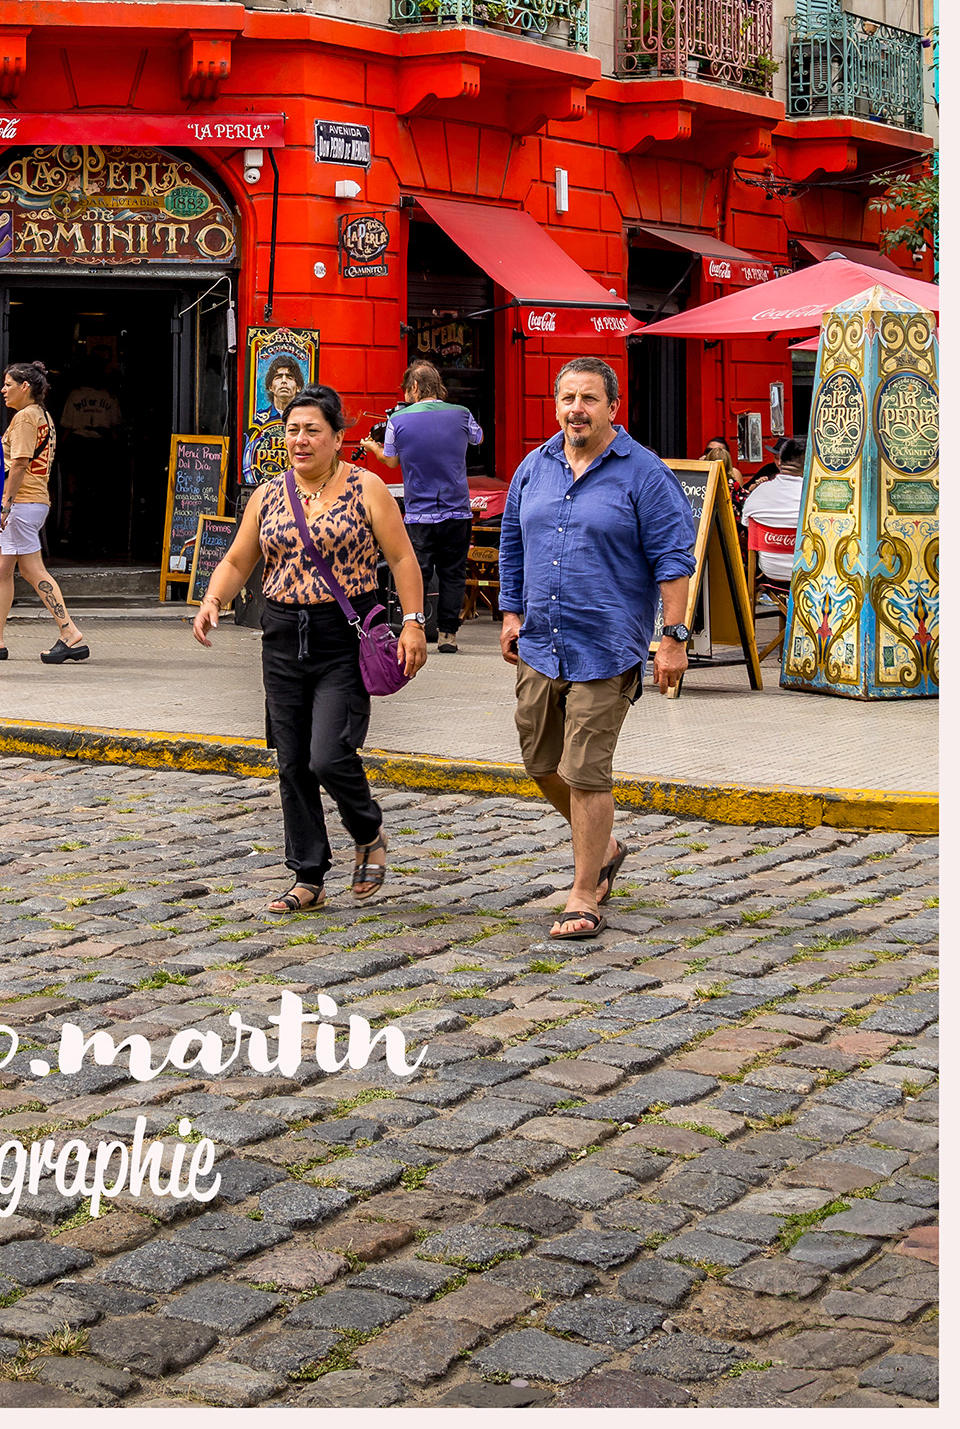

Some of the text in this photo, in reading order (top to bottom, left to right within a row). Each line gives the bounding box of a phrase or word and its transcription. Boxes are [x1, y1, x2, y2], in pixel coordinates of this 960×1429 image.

[329, 125, 362, 137] AVENIDA
[55, 145, 192, 196] PERLA
[111, 196, 160, 207] NOTABLE
[170, 197, 206, 210] 1882
[82, 209, 114, 223] DE
[346, 223, 388, 255] LA PERLA
[348, 265, 384, 277] CAMINITO
[528, 311, 556, 332] Coca-Cola
[275, 333, 295, 343] BAR
[260, 344, 307, 361] NOTABLE
[832, 390, 848, 407] LA
[898, 391, 919, 408] LA
[884, 408, 939, 440] PERLA
[891, 445, 934, 457] CAMINITO
[178, 459, 190, 469] Del
[196, 471, 204, 482] de
